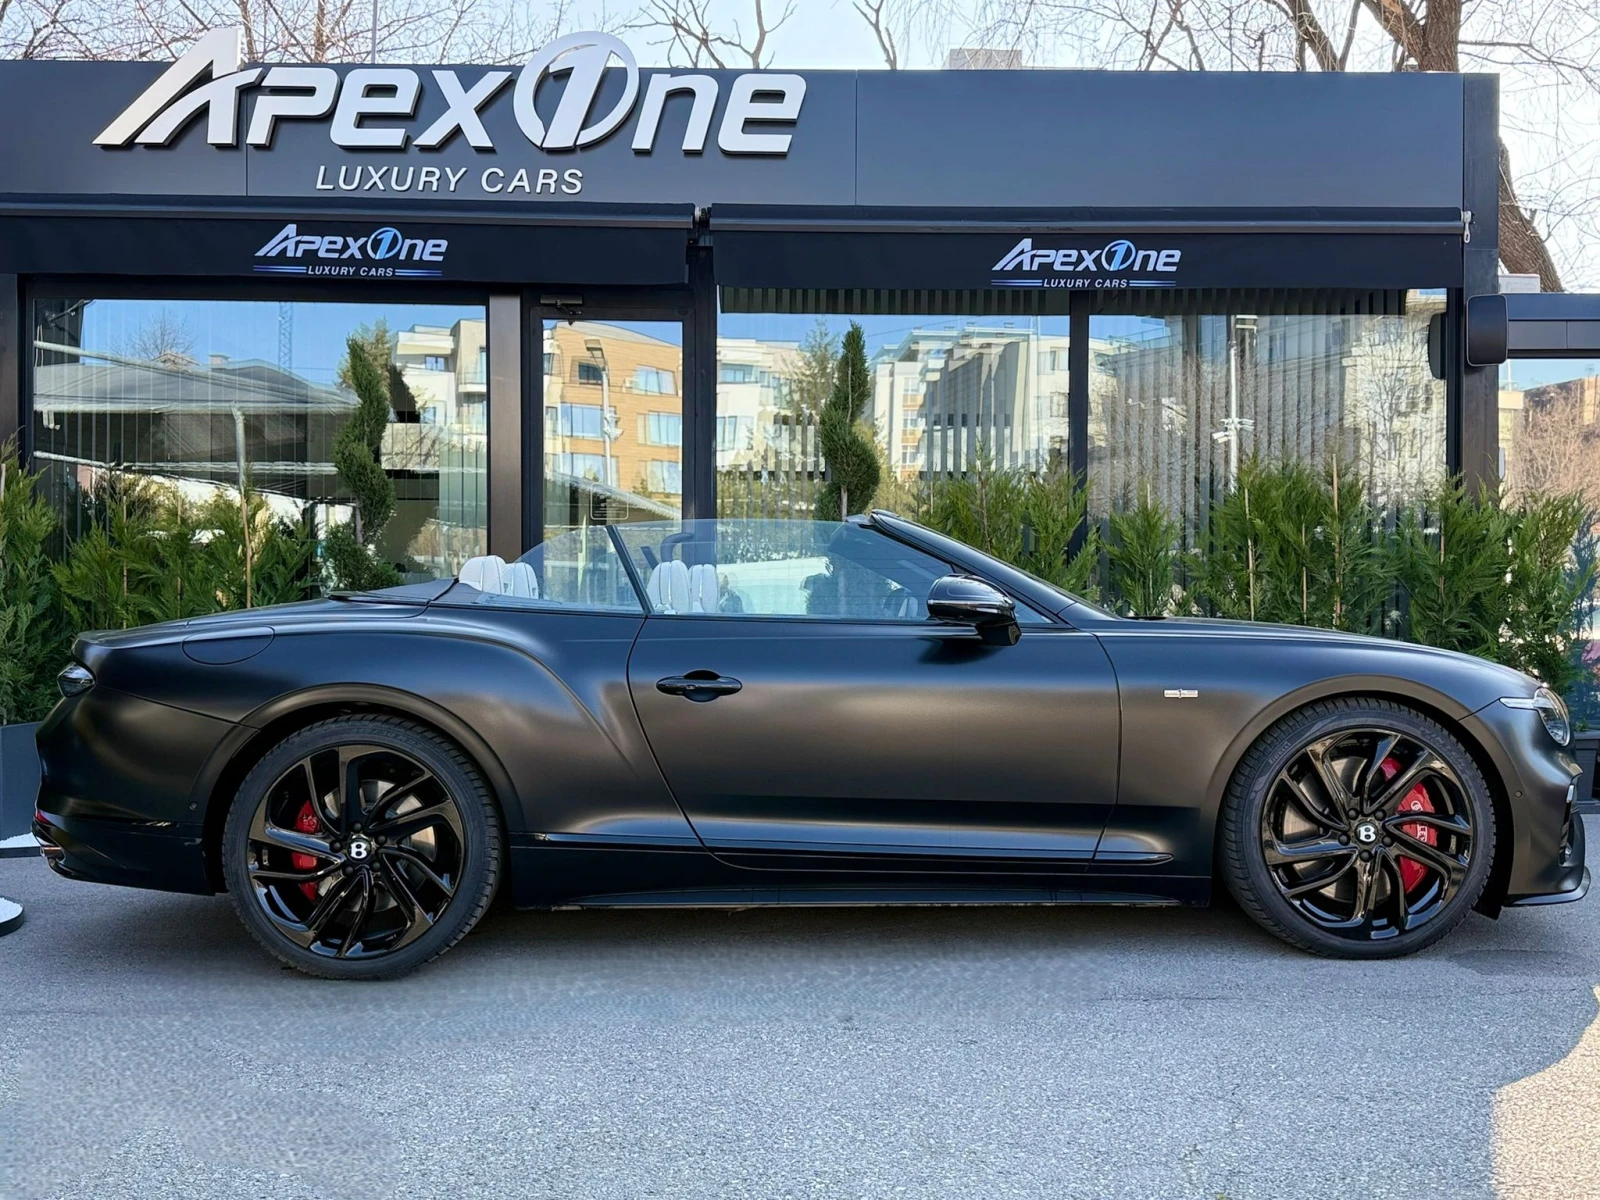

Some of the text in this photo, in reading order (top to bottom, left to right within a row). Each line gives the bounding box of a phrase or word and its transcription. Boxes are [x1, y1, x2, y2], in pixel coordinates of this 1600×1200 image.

[315, 164, 584, 195] LUXURY CARS
[307, 265, 394, 277] LUXURY CARS
[1043, 278, 1128, 289] LUXURY CARS
[1357, 824, 1376, 843] B
[350, 841, 368, 859] B
